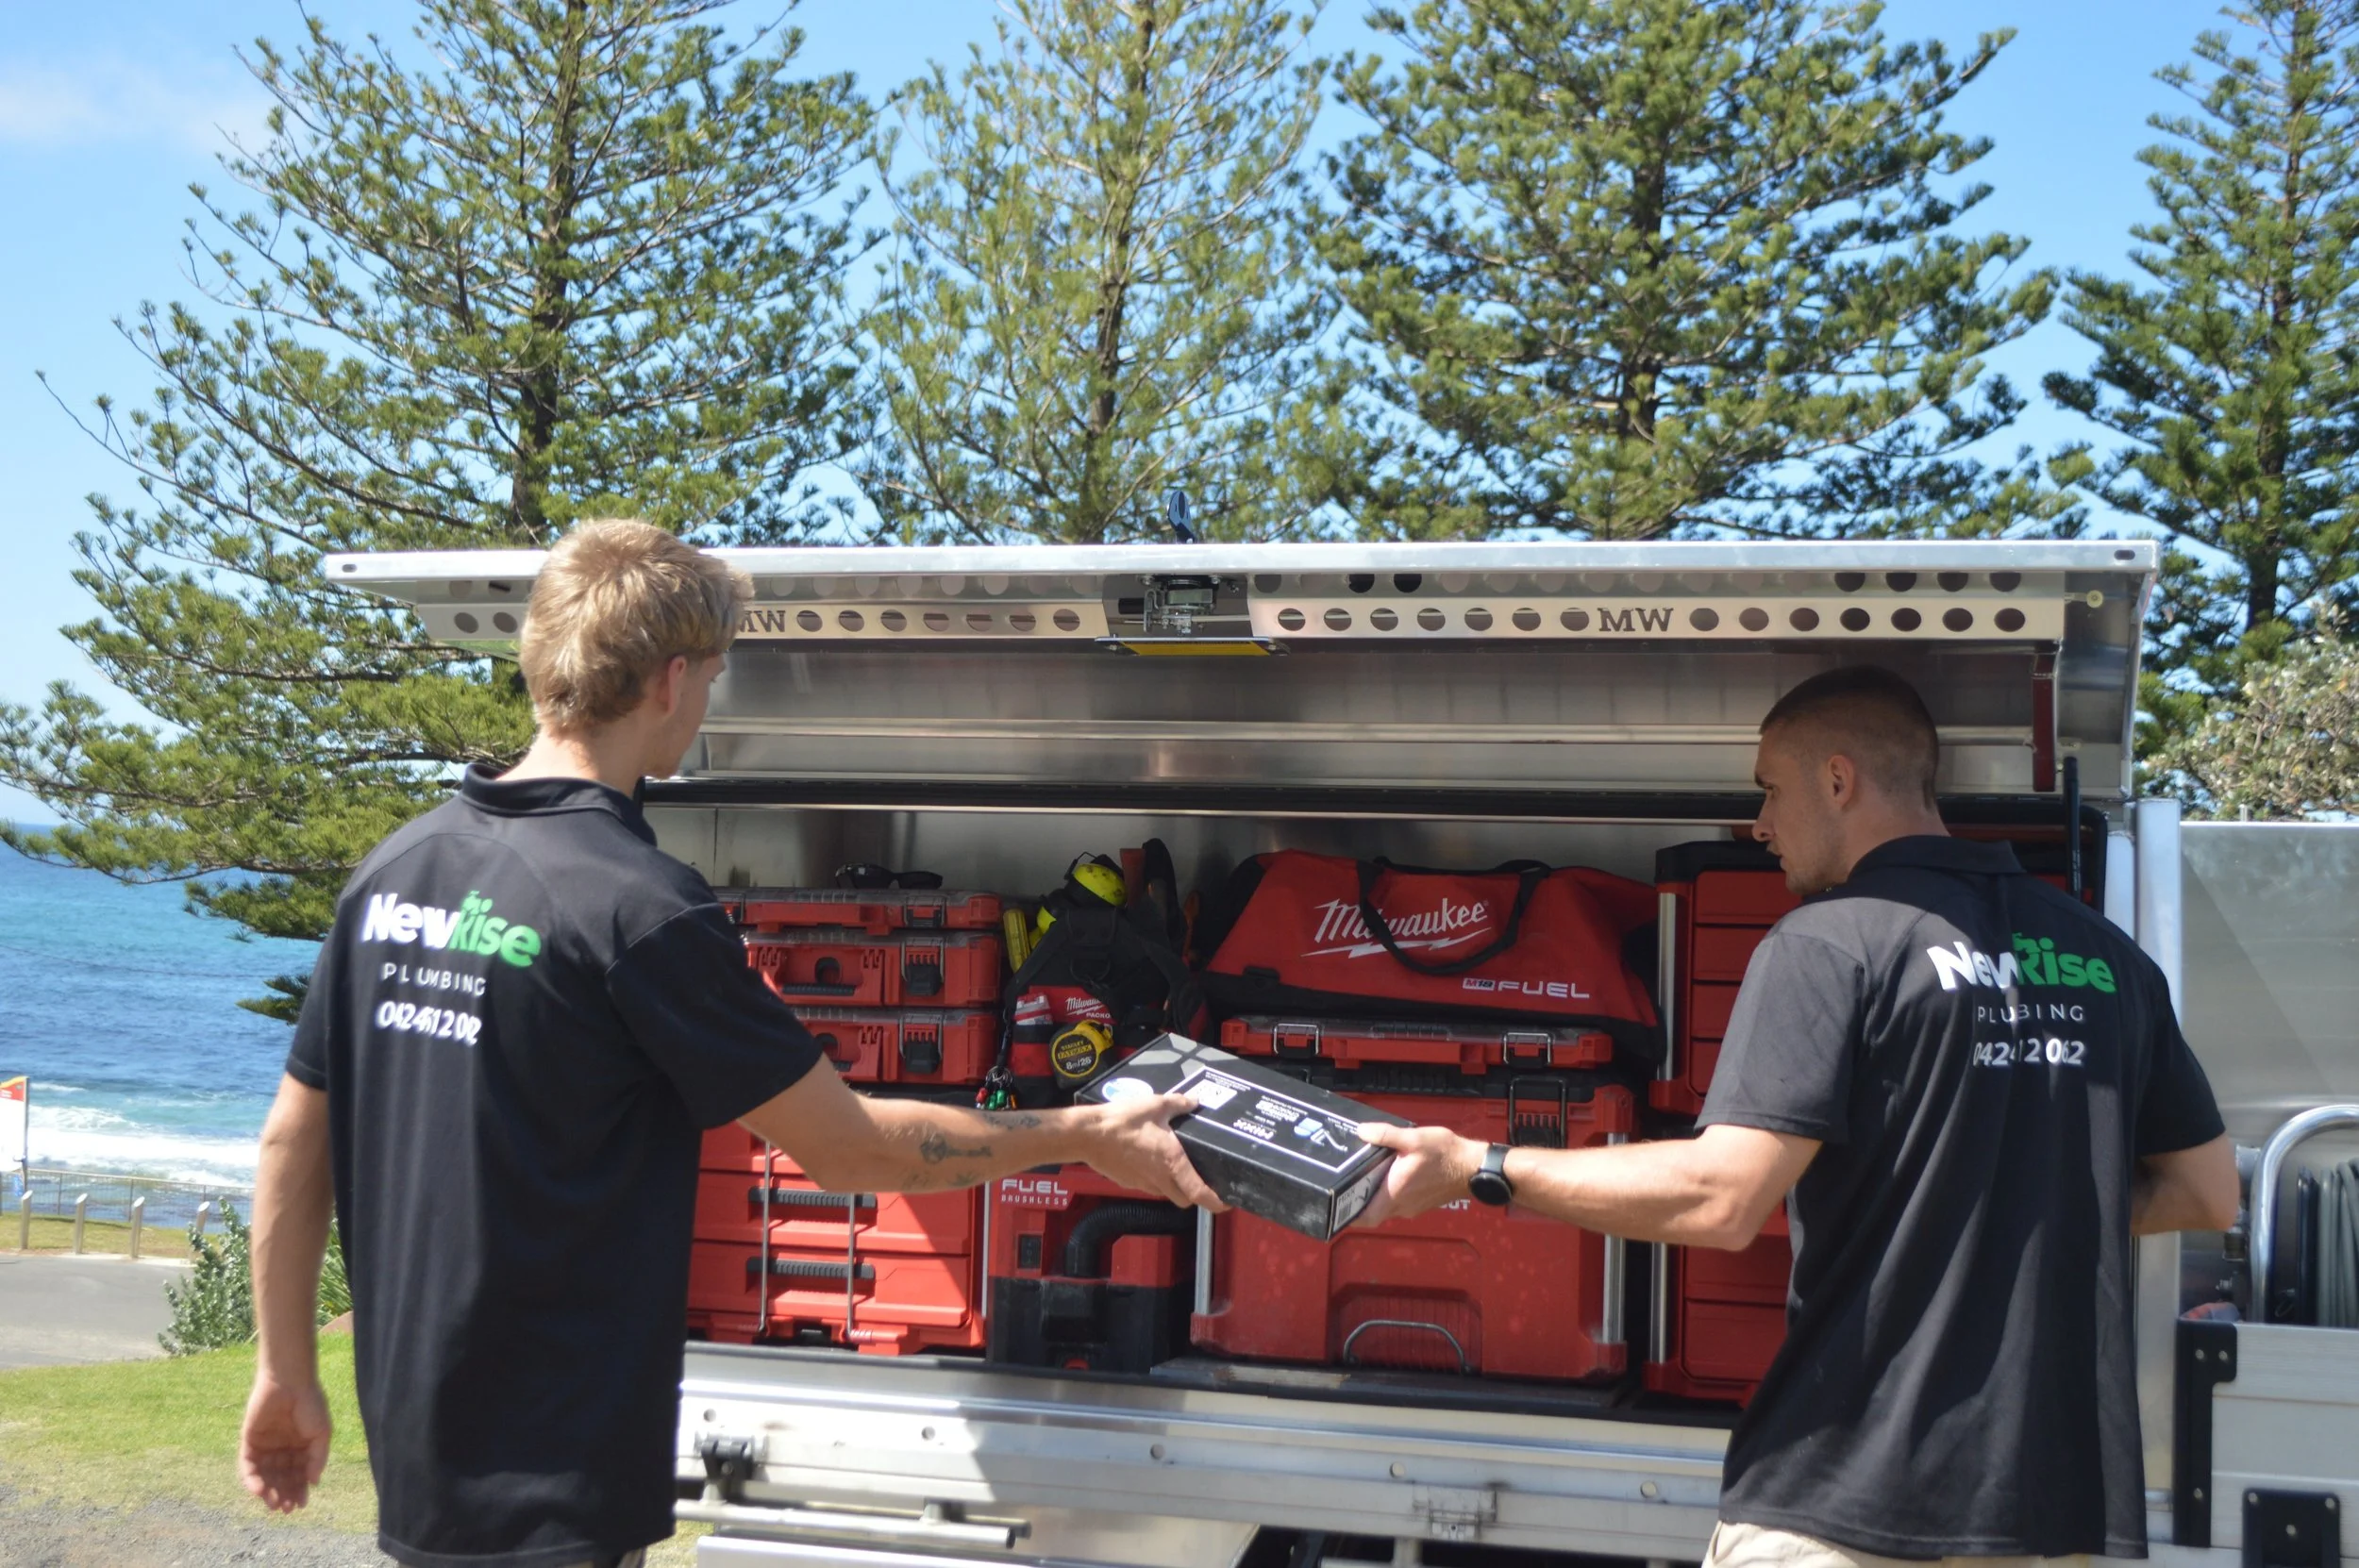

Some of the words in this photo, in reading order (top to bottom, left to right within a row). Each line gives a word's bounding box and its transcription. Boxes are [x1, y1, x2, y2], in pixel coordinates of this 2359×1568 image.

[1597, 607, 1674, 632] MW
[1927, 932, 2116, 993] NewRise
[382, 962, 487, 996] PLUMBING
[1498, 980, 1590, 998] FUEL
[1002, 1178, 1068, 1194] FUEL
[1001, 1193, 1068, 1206] BRUSHLESS
